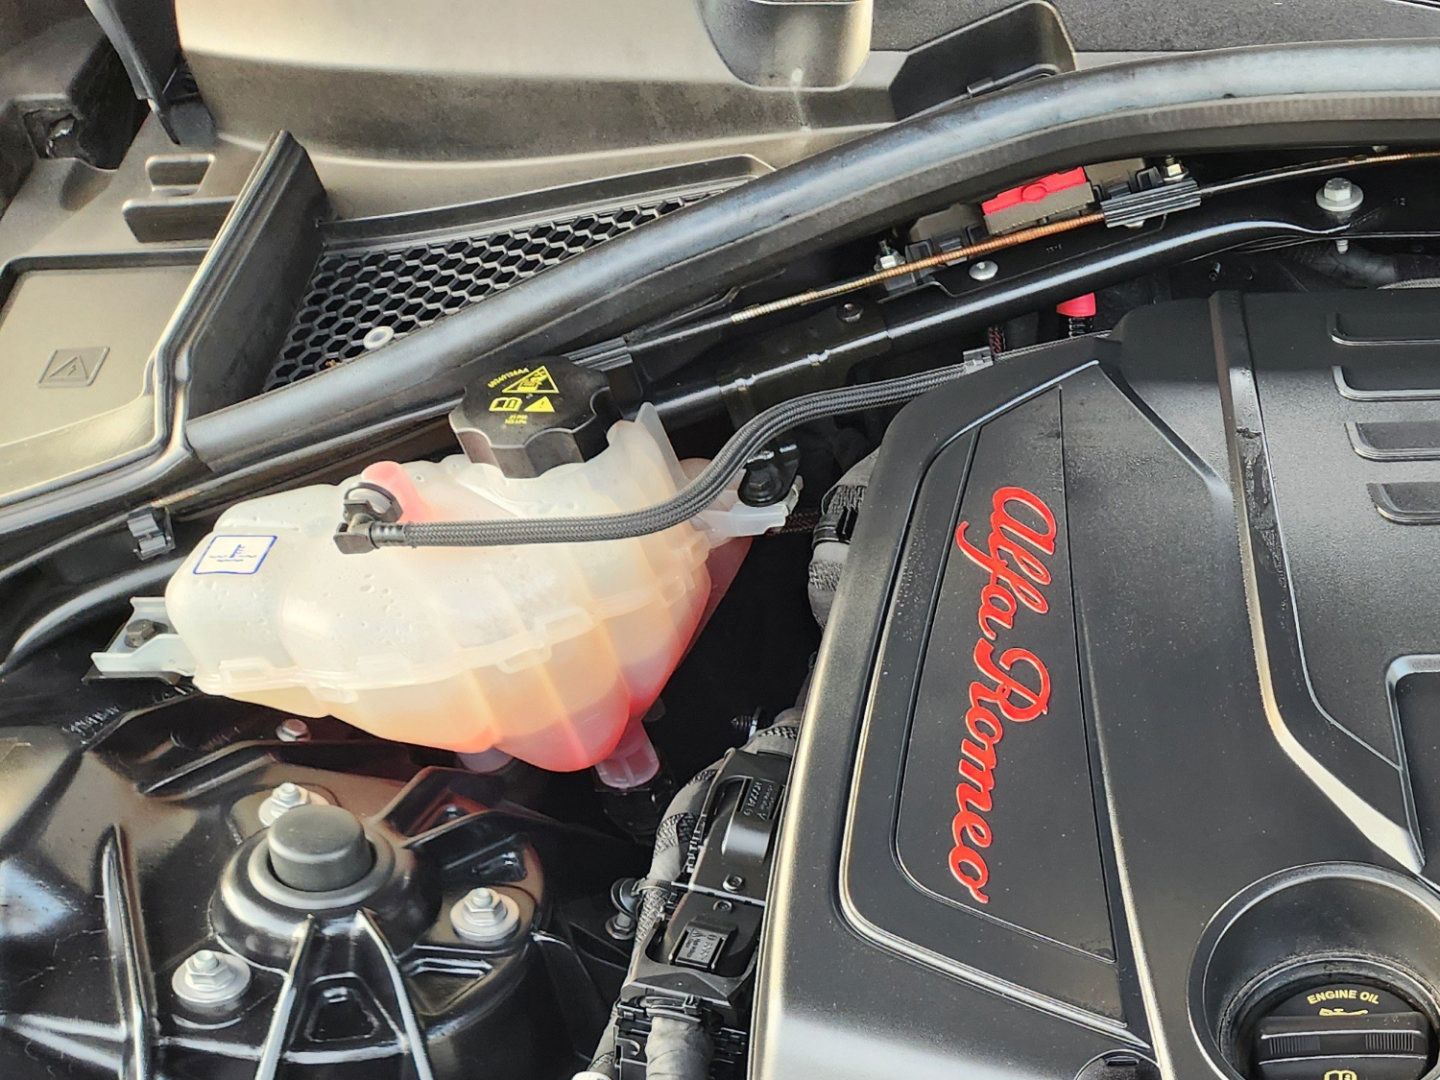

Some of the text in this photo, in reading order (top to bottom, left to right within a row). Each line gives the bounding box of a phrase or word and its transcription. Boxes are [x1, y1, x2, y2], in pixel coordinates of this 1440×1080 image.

[948, 486, 1057, 904] Alfa Romeo
[1306, 989, 1380, 1005] ENGINE OIL
